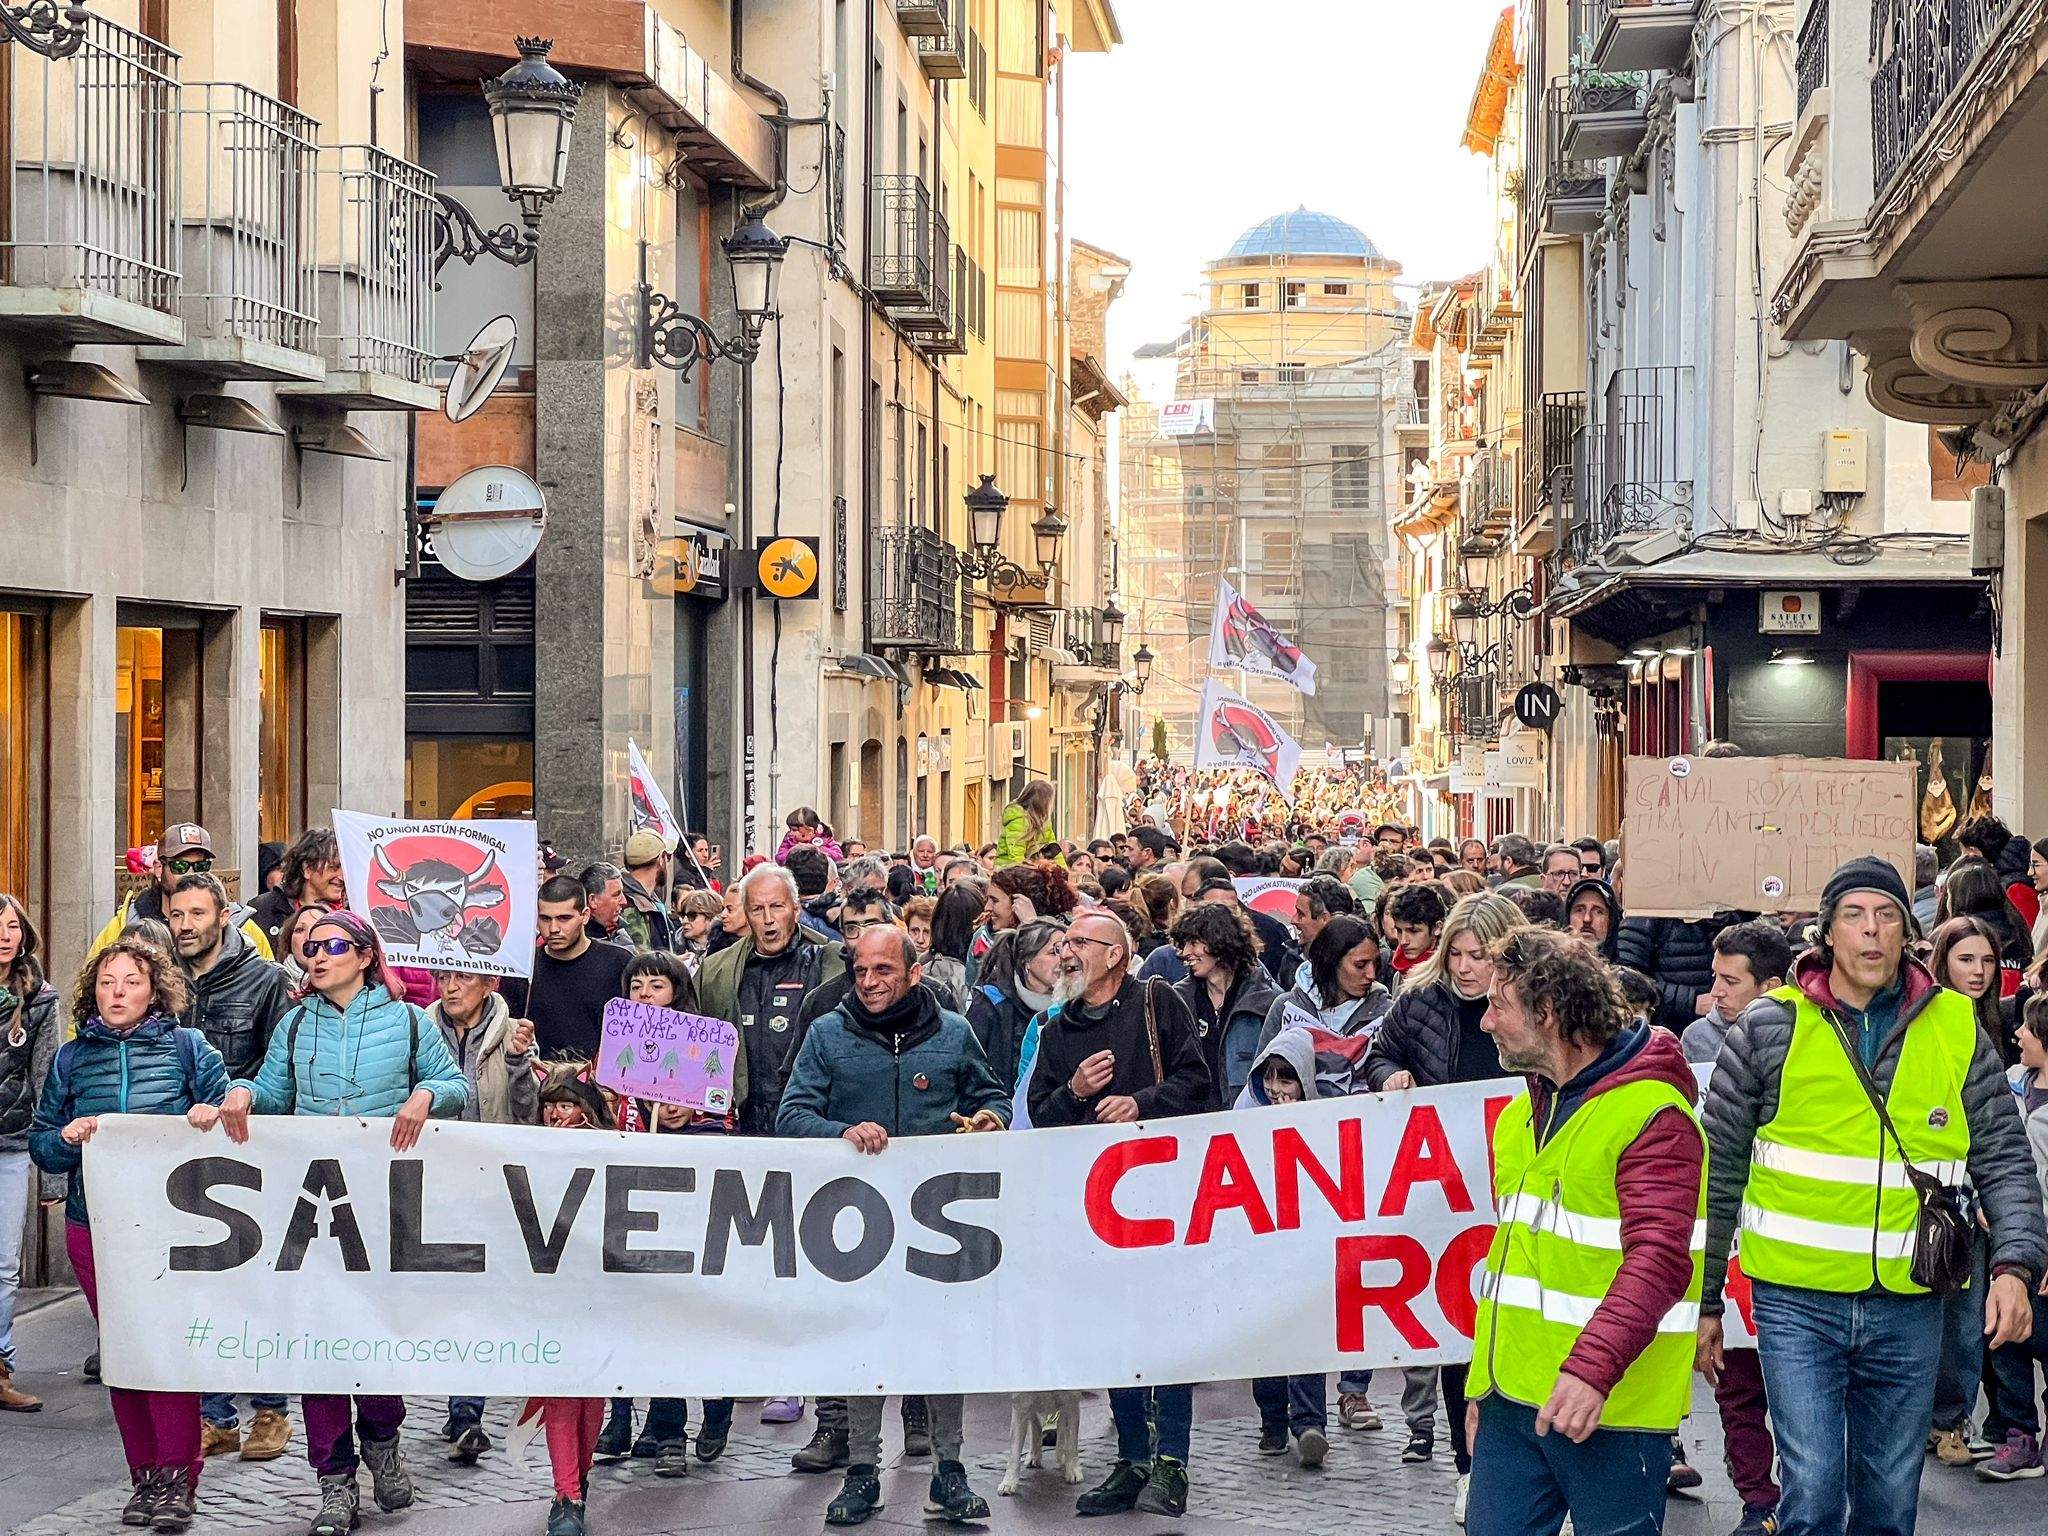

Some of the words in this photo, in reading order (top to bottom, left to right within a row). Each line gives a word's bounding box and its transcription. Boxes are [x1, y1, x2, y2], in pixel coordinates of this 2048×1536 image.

[1524, 694, 1551, 717] IN
[1506, 756, 1535, 765] LOVIZ
[1636, 774, 1728, 810] CANAL
[1746, 777, 1805, 807] ROYA
[366, 827, 384, 842] NO
[386, 824, 420, 835] UNIÓN
[422, 822, 507, 854] ASTÚN-FORMIGAL
[1241, 888, 1253, 900] NO
[387, 951, 516, 974] alvemosCanalRoya
[606, 1019, 677, 1040] CANAL
[166, 1155, 1003, 1284] SALVEMOS
